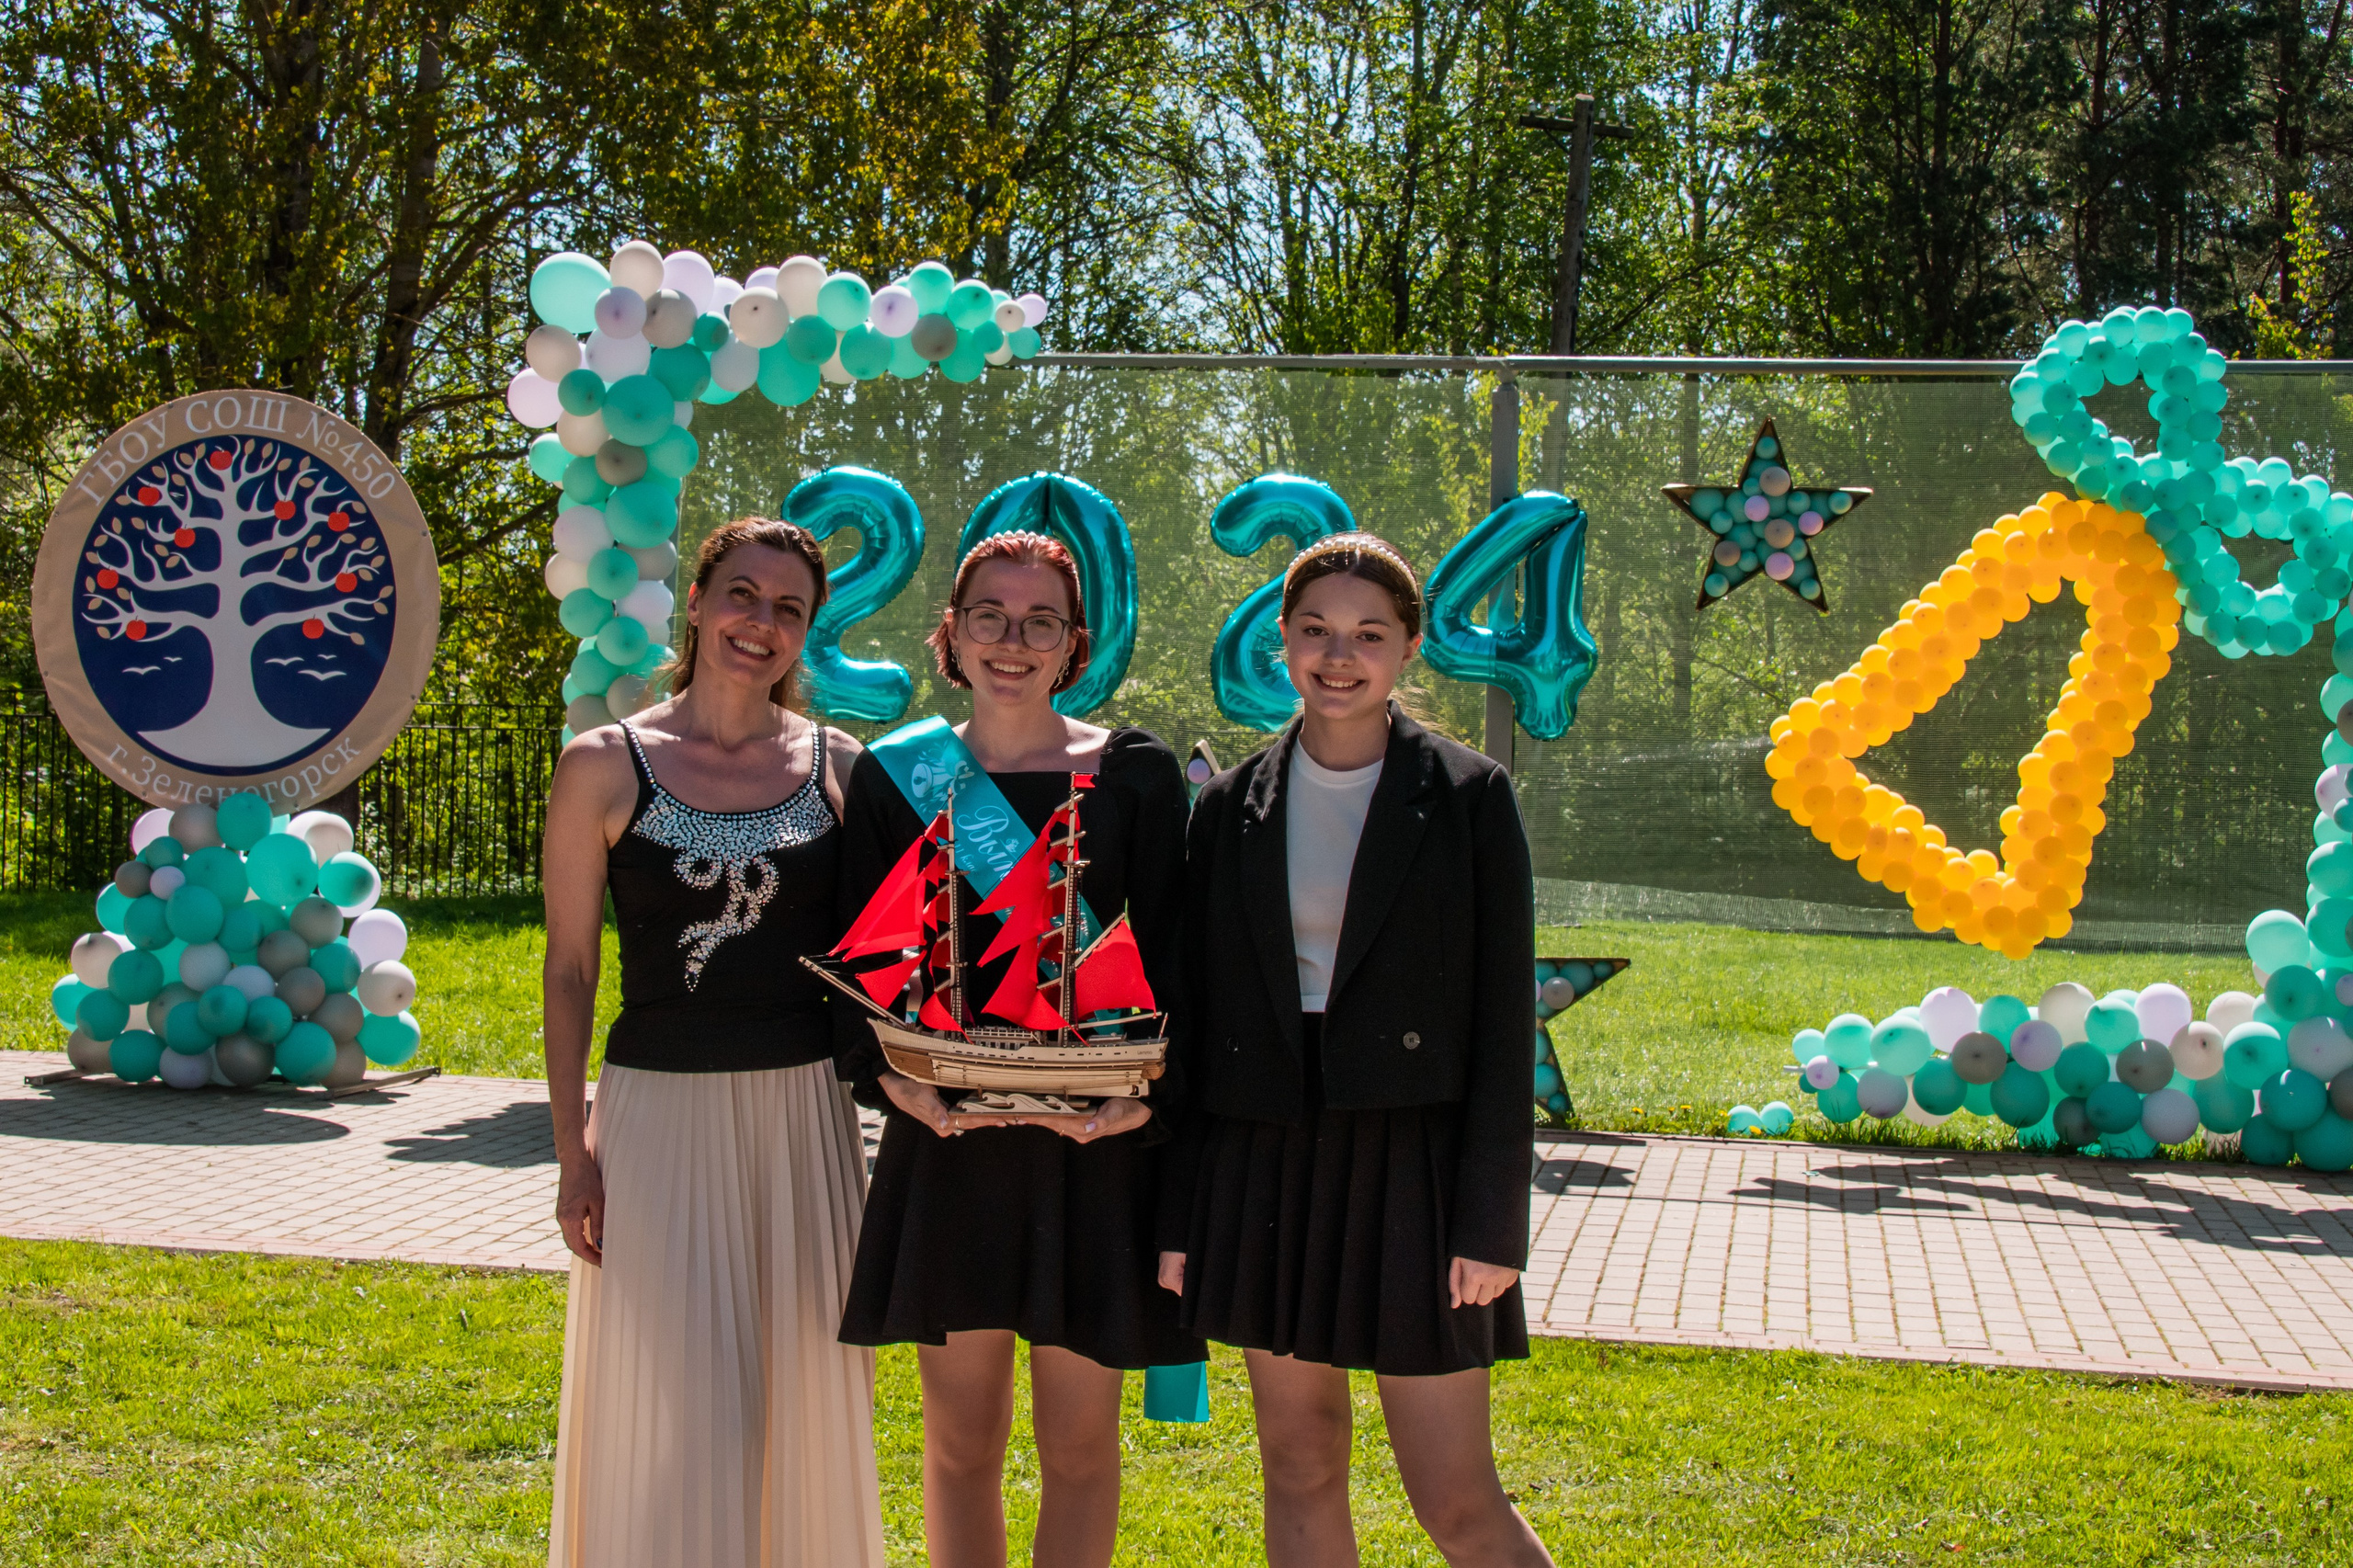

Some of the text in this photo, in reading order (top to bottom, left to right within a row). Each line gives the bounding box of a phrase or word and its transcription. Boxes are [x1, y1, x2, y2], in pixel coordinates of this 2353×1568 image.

[75, 396, 396, 506] ГБОУ СОШ №450
